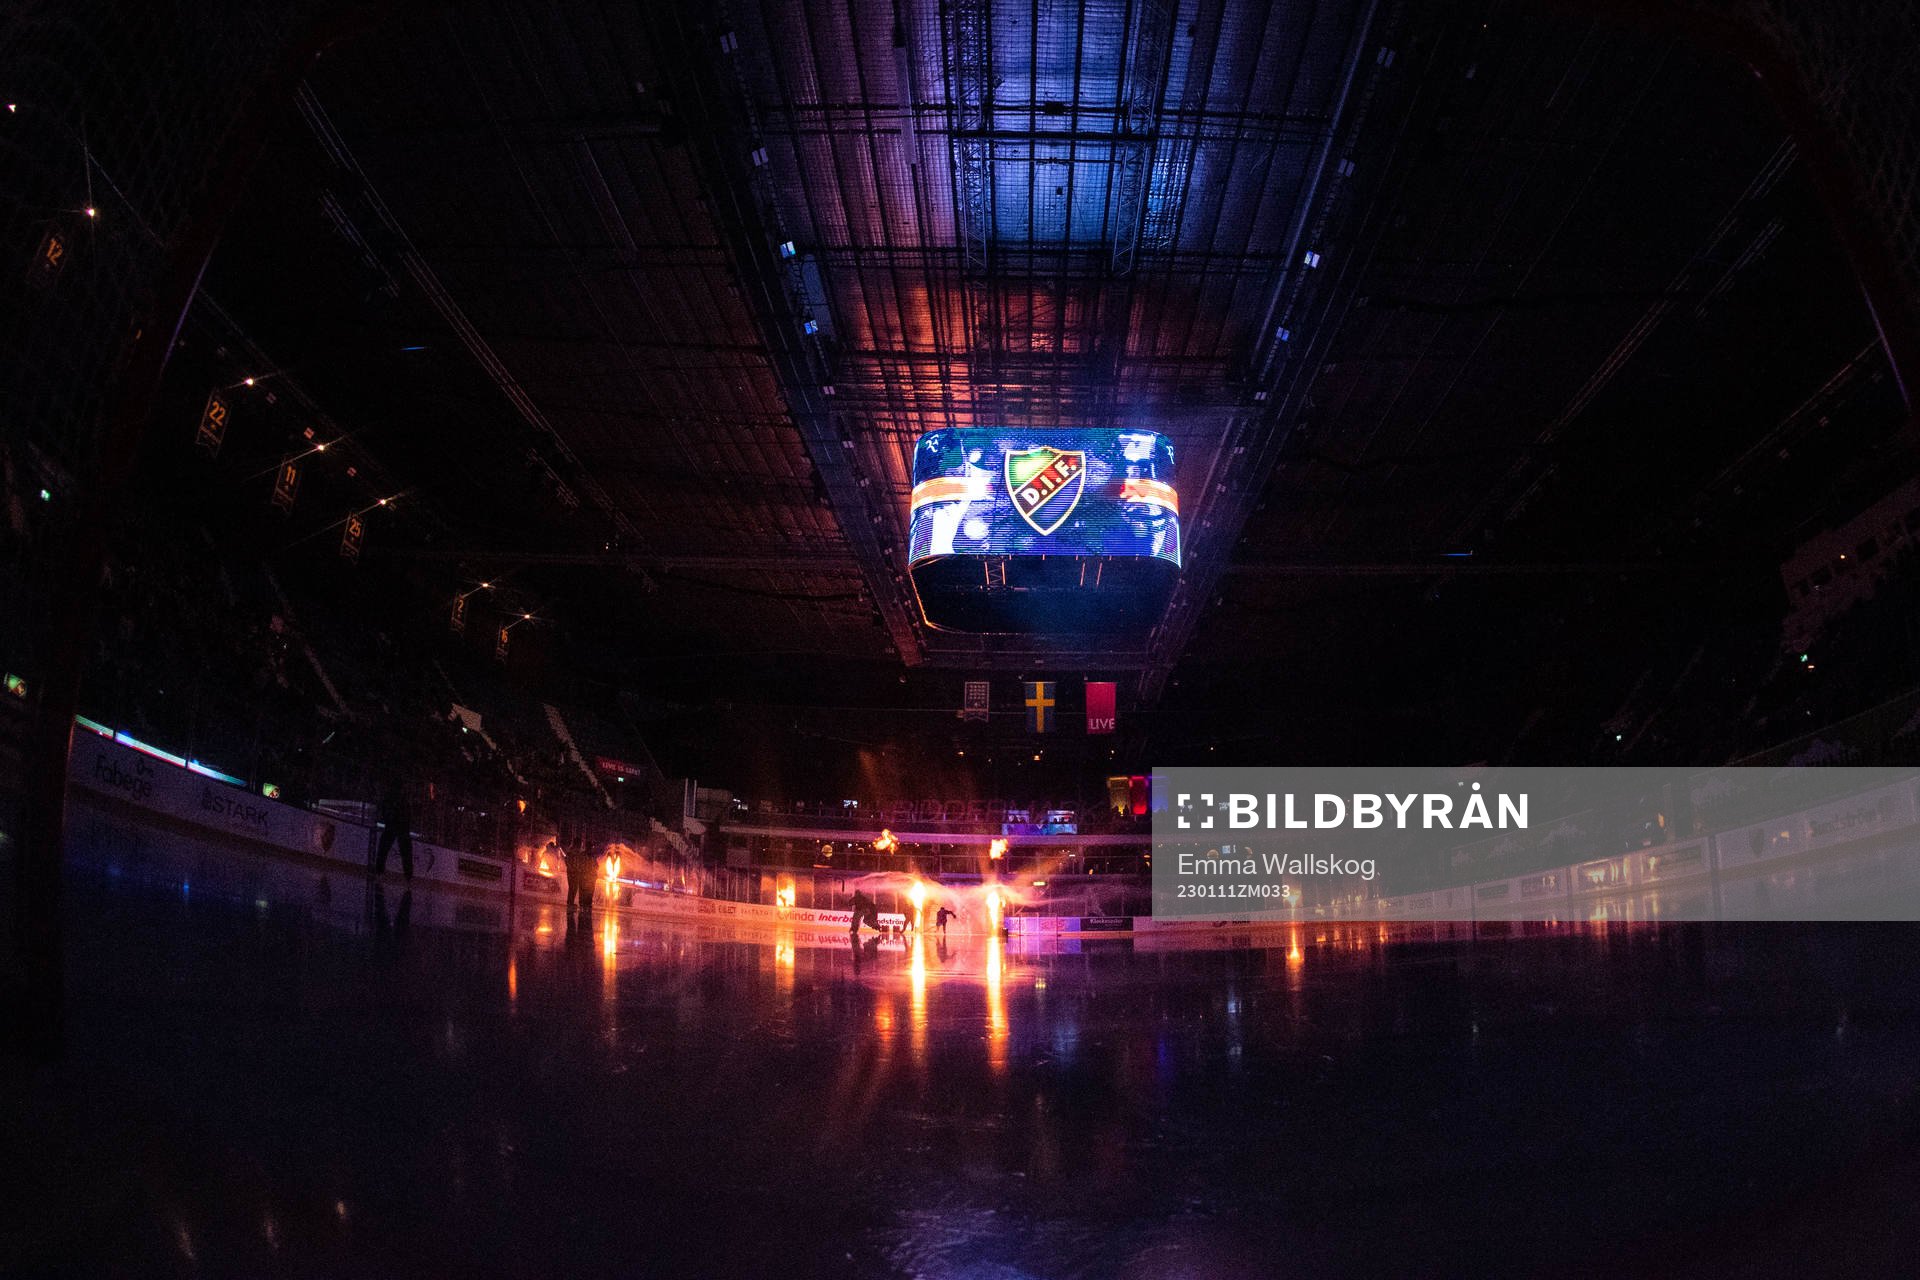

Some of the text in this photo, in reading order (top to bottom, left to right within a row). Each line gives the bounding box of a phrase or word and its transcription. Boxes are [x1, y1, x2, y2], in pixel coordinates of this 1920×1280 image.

[46, 237, 63, 266] 12
[208, 400, 226, 427] 22
[285, 464, 297, 485] 11
[1020, 459, 1077, 507] D.I.F.
[348, 517, 361, 537] 25
[1089, 718, 1116, 730] LIVE
[94, 754, 153, 801] Fabege
[212, 795, 269, 826] STARK
